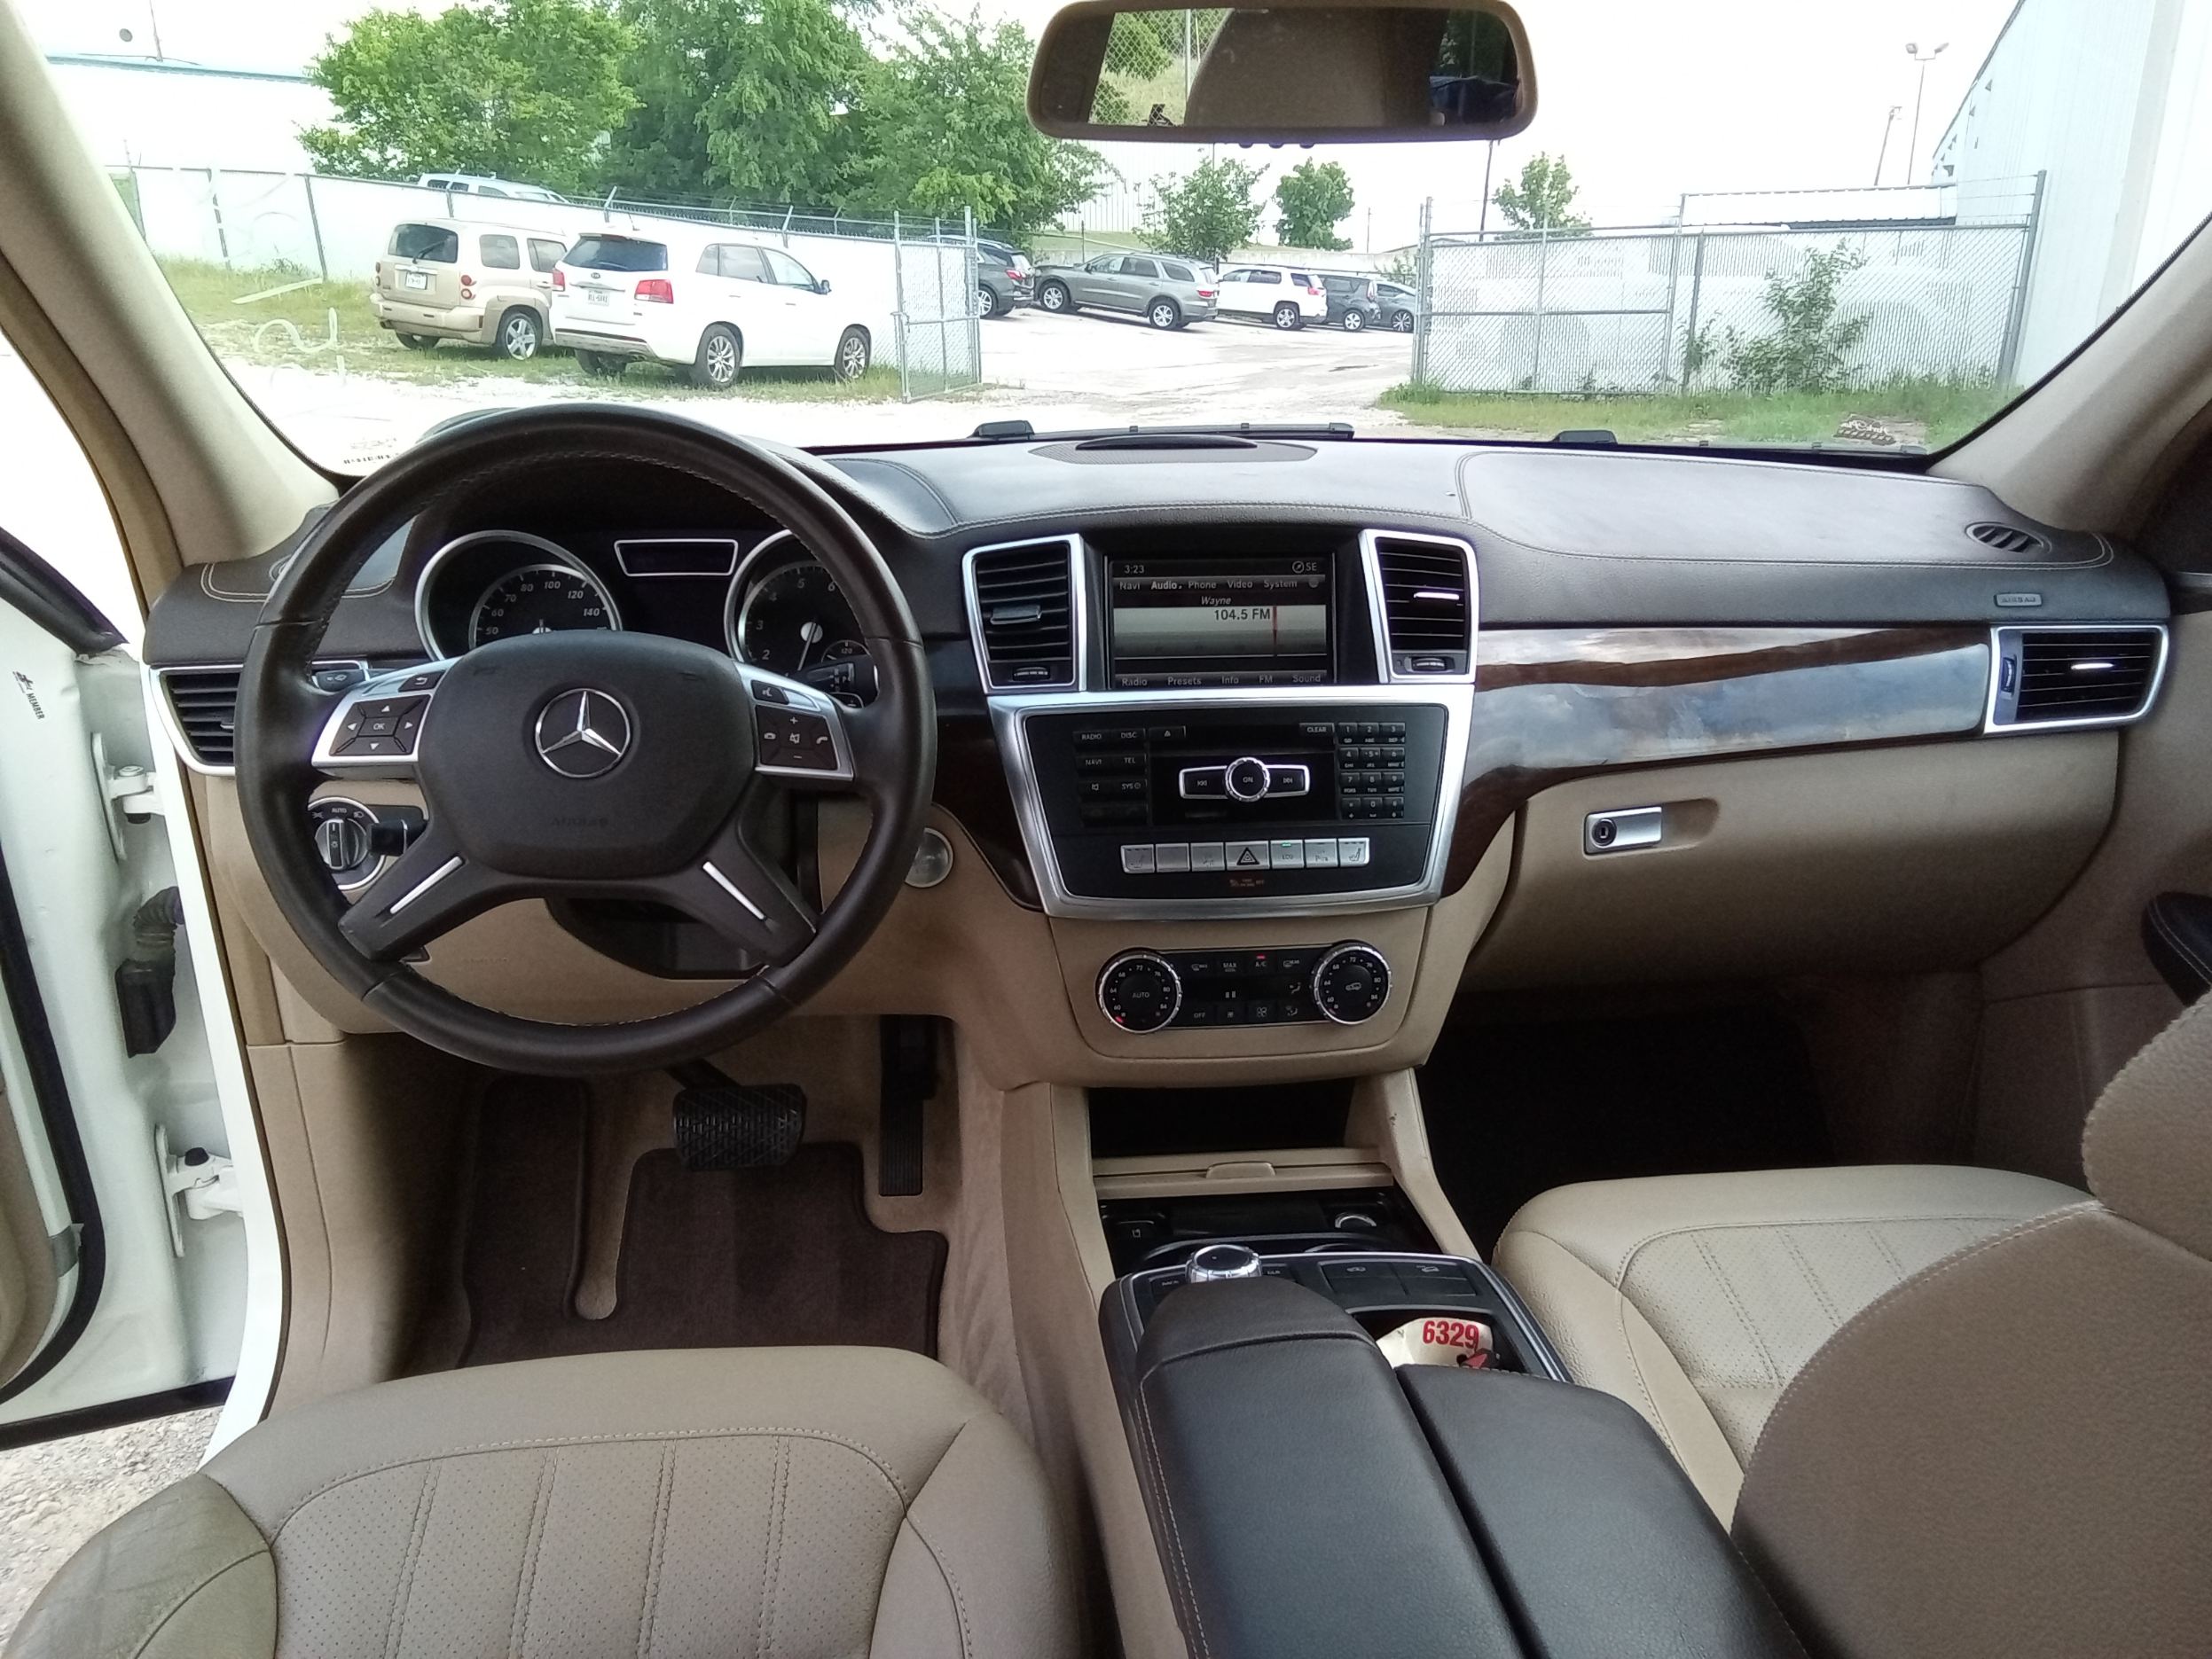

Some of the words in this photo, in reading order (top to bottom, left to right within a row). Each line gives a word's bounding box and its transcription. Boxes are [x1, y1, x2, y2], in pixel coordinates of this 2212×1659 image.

[1124, 564, 1145, 574] 3:23
[1305, 562, 1317, 571] SE
[1120, 581, 1140, 591] Navi
[1151, 581, 1177, 590] Audio
[1188, 580, 1216, 589] Phone
[1227, 579, 1253, 588] Video
[1264, 579, 1297, 590] System
[1201, 596, 1232, 606] Wayne
[1215, 609, 1248, 620] 104.5
[1252, 608, 1271, 619] FM
[756, 620, 763, 630] 3
[762, 650, 770, 660] 2
[1122, 677, 1147, 687] Radio
[1167, 677, 1201, 685] Presets
[1222, 676, 1239, 685] Info
[1259, 675, 1273, 683] FM
[1293, 674, 1321, 683] Sound
[26, 693, 45, 720] MEMBER
[1423, 1320, 1479, 1350] 6329
